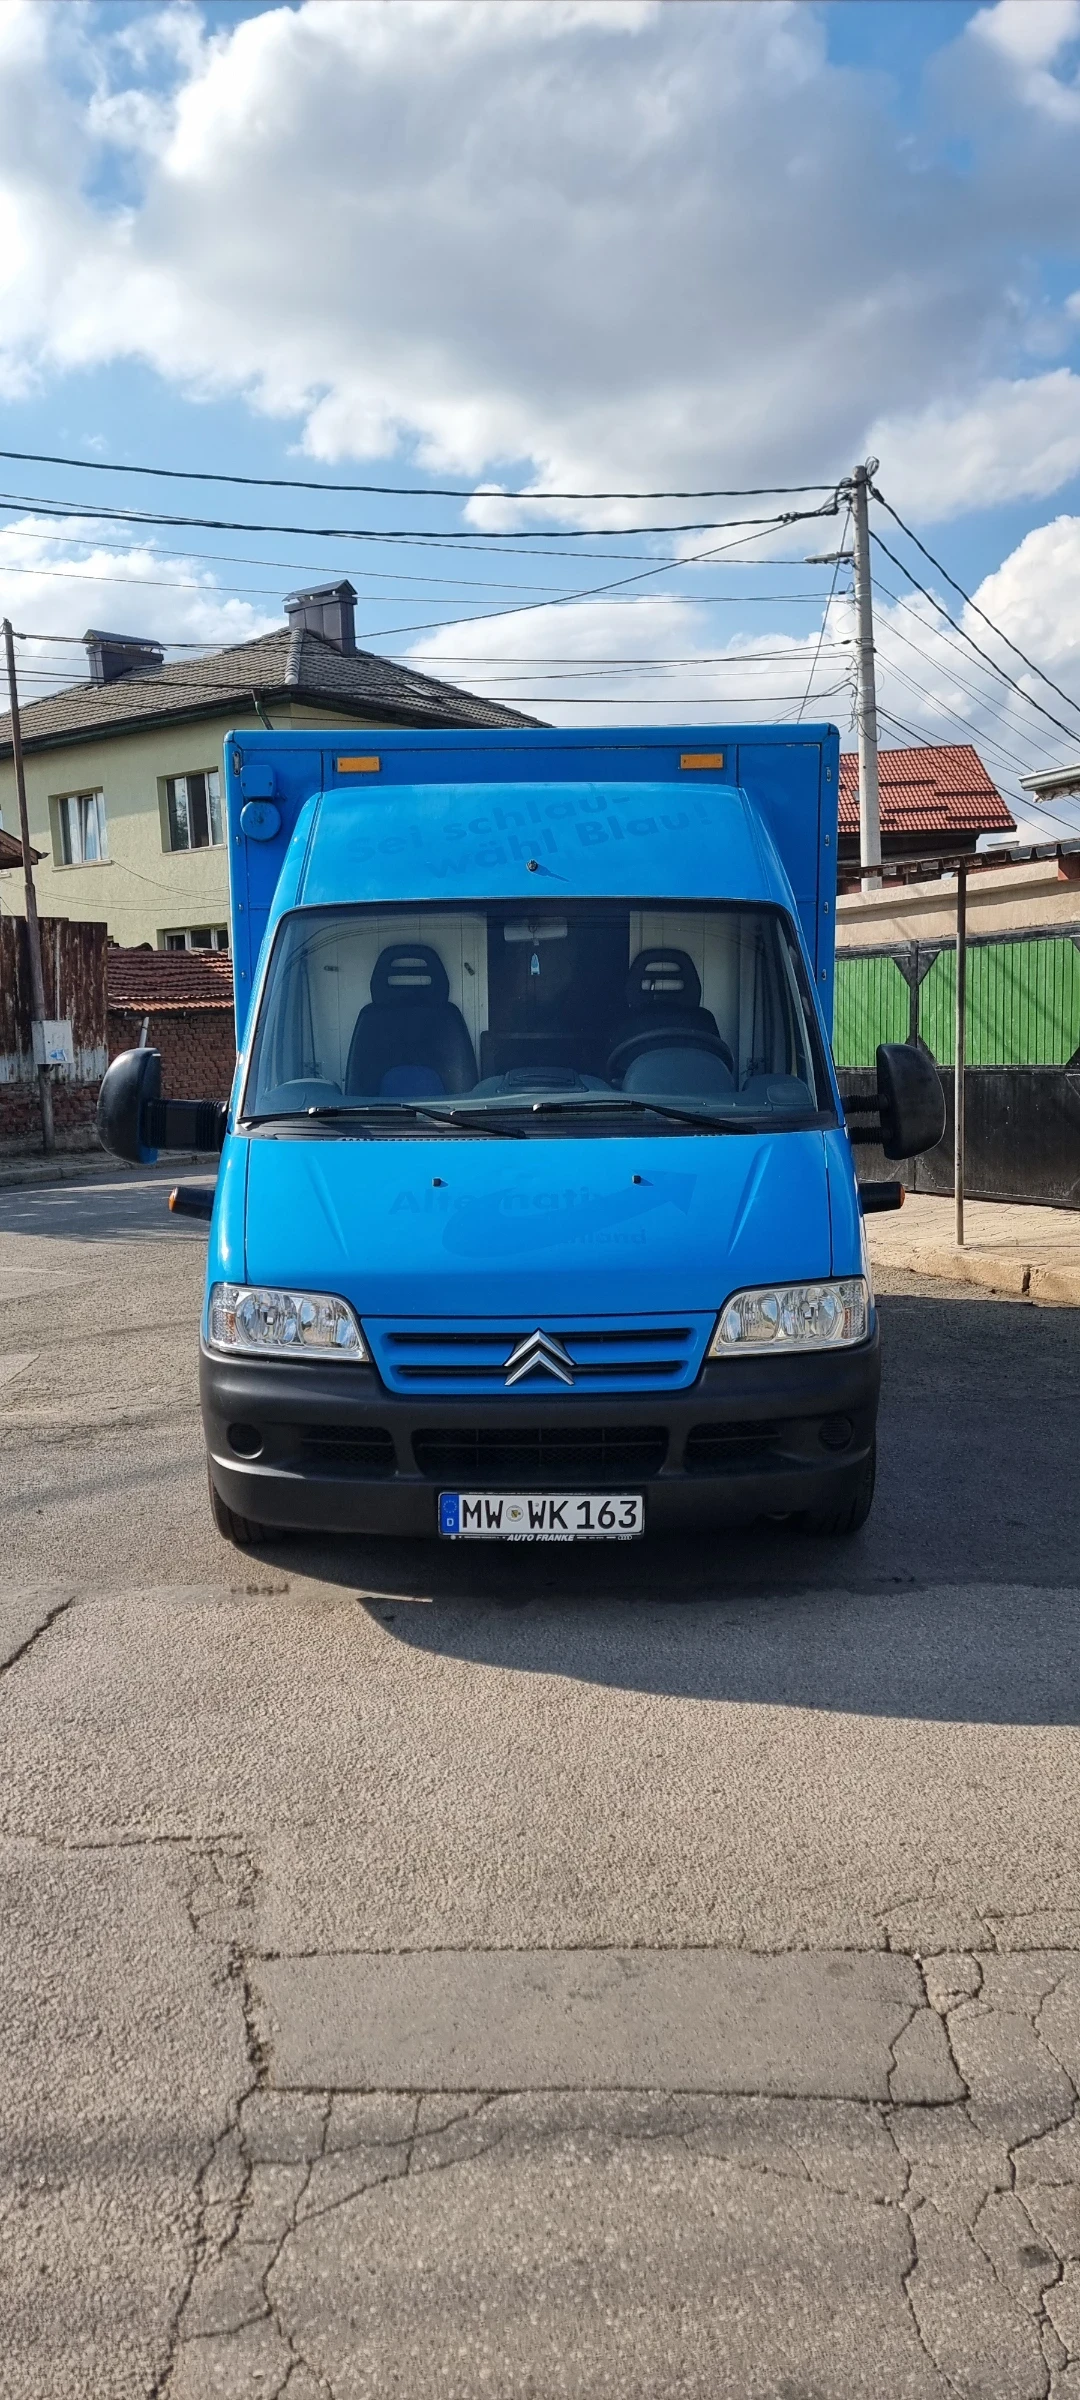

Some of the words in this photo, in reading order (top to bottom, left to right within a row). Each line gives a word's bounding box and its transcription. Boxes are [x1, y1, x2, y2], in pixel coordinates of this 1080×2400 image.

[347, 825, 424, 863] Sei
[424, 829, 558, 878] wähl
[575, 801, 713, 847] Blau!
[446, 1518, 454, 1527] D
[462, 1500, 503, 1529] MW
[527, 1500, 569, 1529] WK
[576, 1500, 637, 1529] 163
[506, 1534, 534, 1542] AUTO
[535, 1534, 575, 1542] FRANKE
